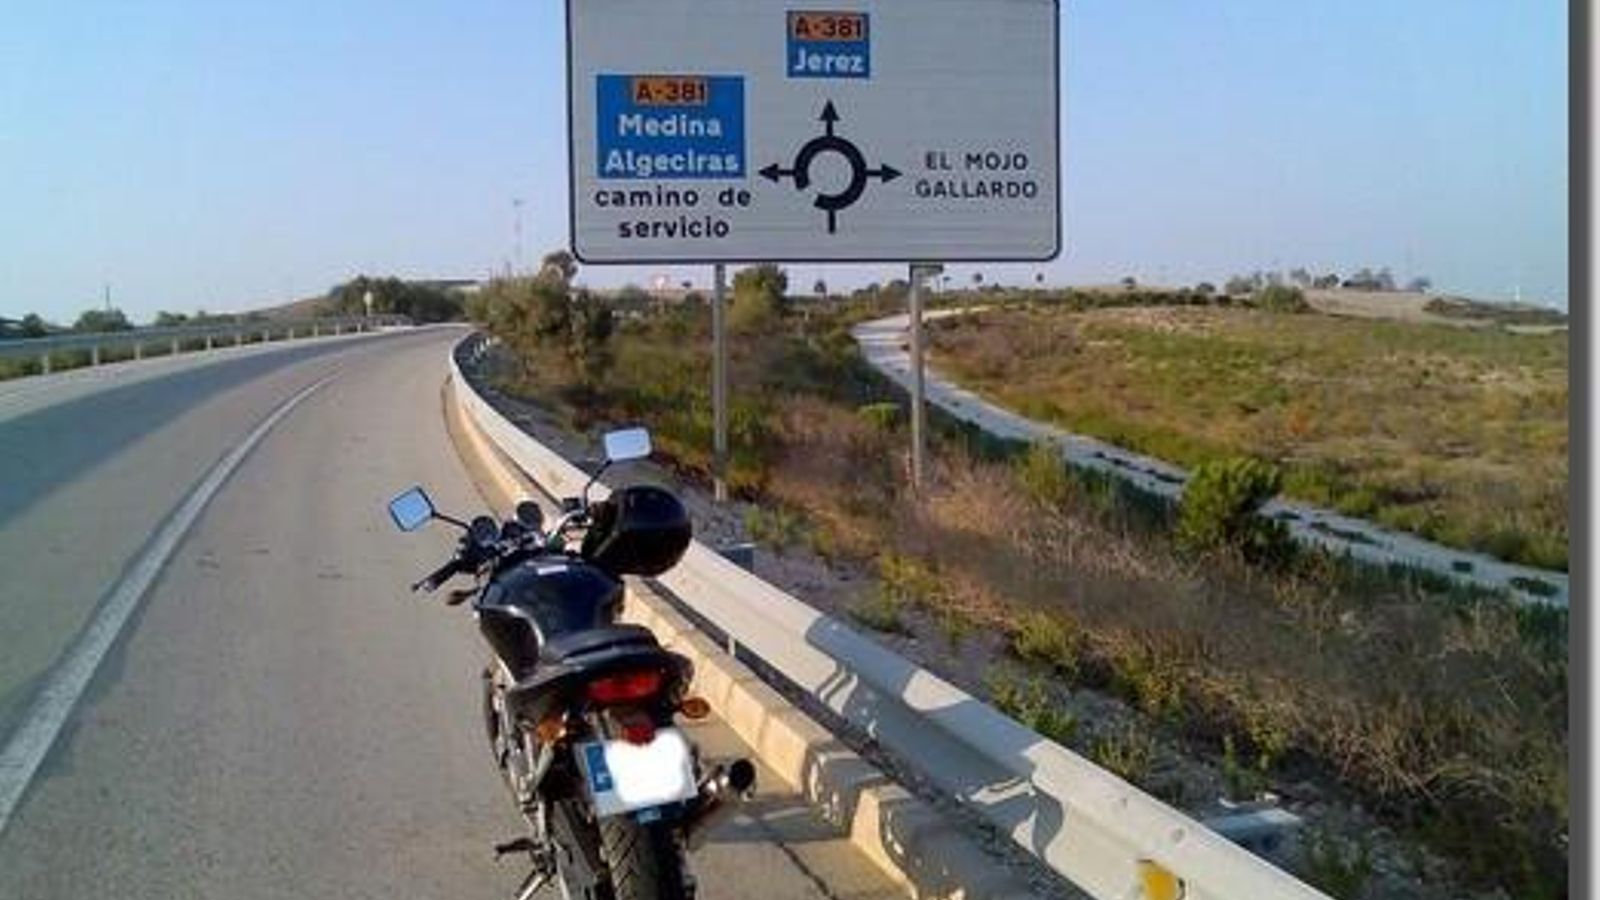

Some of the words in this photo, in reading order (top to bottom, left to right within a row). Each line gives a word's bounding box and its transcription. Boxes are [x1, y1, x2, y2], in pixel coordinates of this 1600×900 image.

[793, 17, 863, 38] A-381
[794, 47, 865, 73] Jerez
[637, 82, 707, 101] A-381
[619, 115, 722, 137] Medina
[605, 150, 739, 176] Algeciras
[925, 152, 953, 171] EL
[965, 152, 1028, 171] MOJO
[595, 186, 700, 207] camino
[718, 186, 751, 207] de
[915, 180, 1038, 199] GALLARDO
[618, 216, 730, 239] servicio
